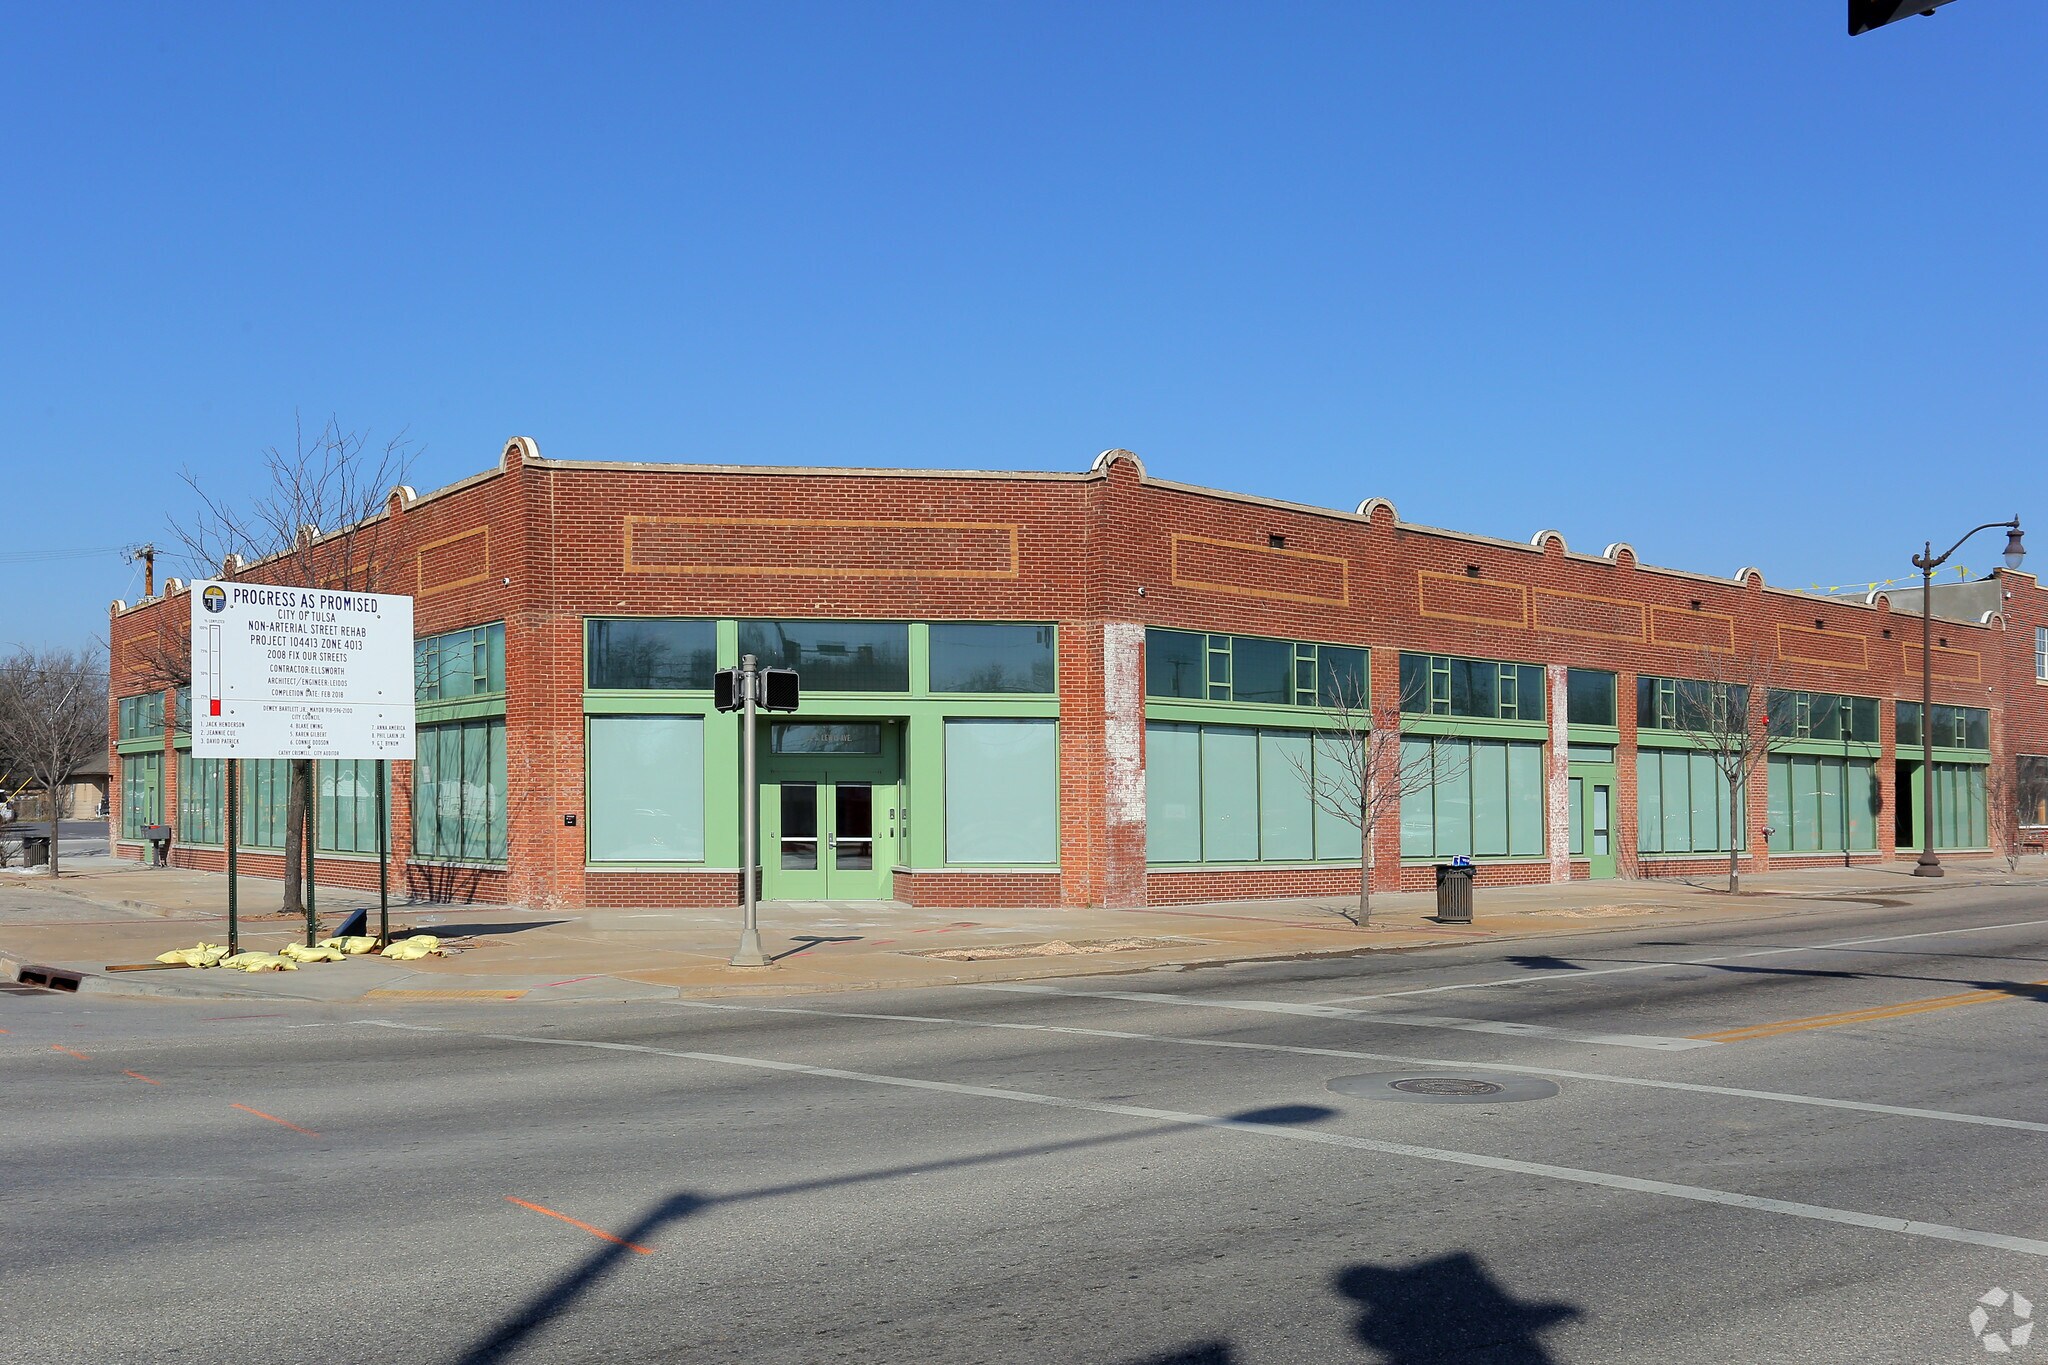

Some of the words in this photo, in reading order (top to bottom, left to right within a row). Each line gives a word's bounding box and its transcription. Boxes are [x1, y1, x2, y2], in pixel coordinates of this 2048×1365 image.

[234, 588, 296, 608] PROGRESS
[300, 594, 315, 609] AS
[320, 595, 378, 613] PROMISED
[278, 609, 296, 620] CITY
[298, 610, 309, 621] OF
[312, 612, 336, 623] TULSA
[248, 620, 308, 634] NON-ARTERIAL
[310, 624, 338, 636] STREET
[340, 626, 367, 638] REHAB
[250, 634, 287, 647] PROJECT
[290, 637, 318, 648] 104413
[322, 638, 342, 650] ZONE
[344, 640, 363, 651] 4013
[267, 650, 286, 660] 2008
[288, 650, 300, 660] FIX
[302, 651, 317, 661] OUR
[319, 652, 348, 662] STREETS
[271, 688, 304, 697] COMPLETION
[321, 690, 331, 698] FEB
[332, 691, 344, 699] 2018
